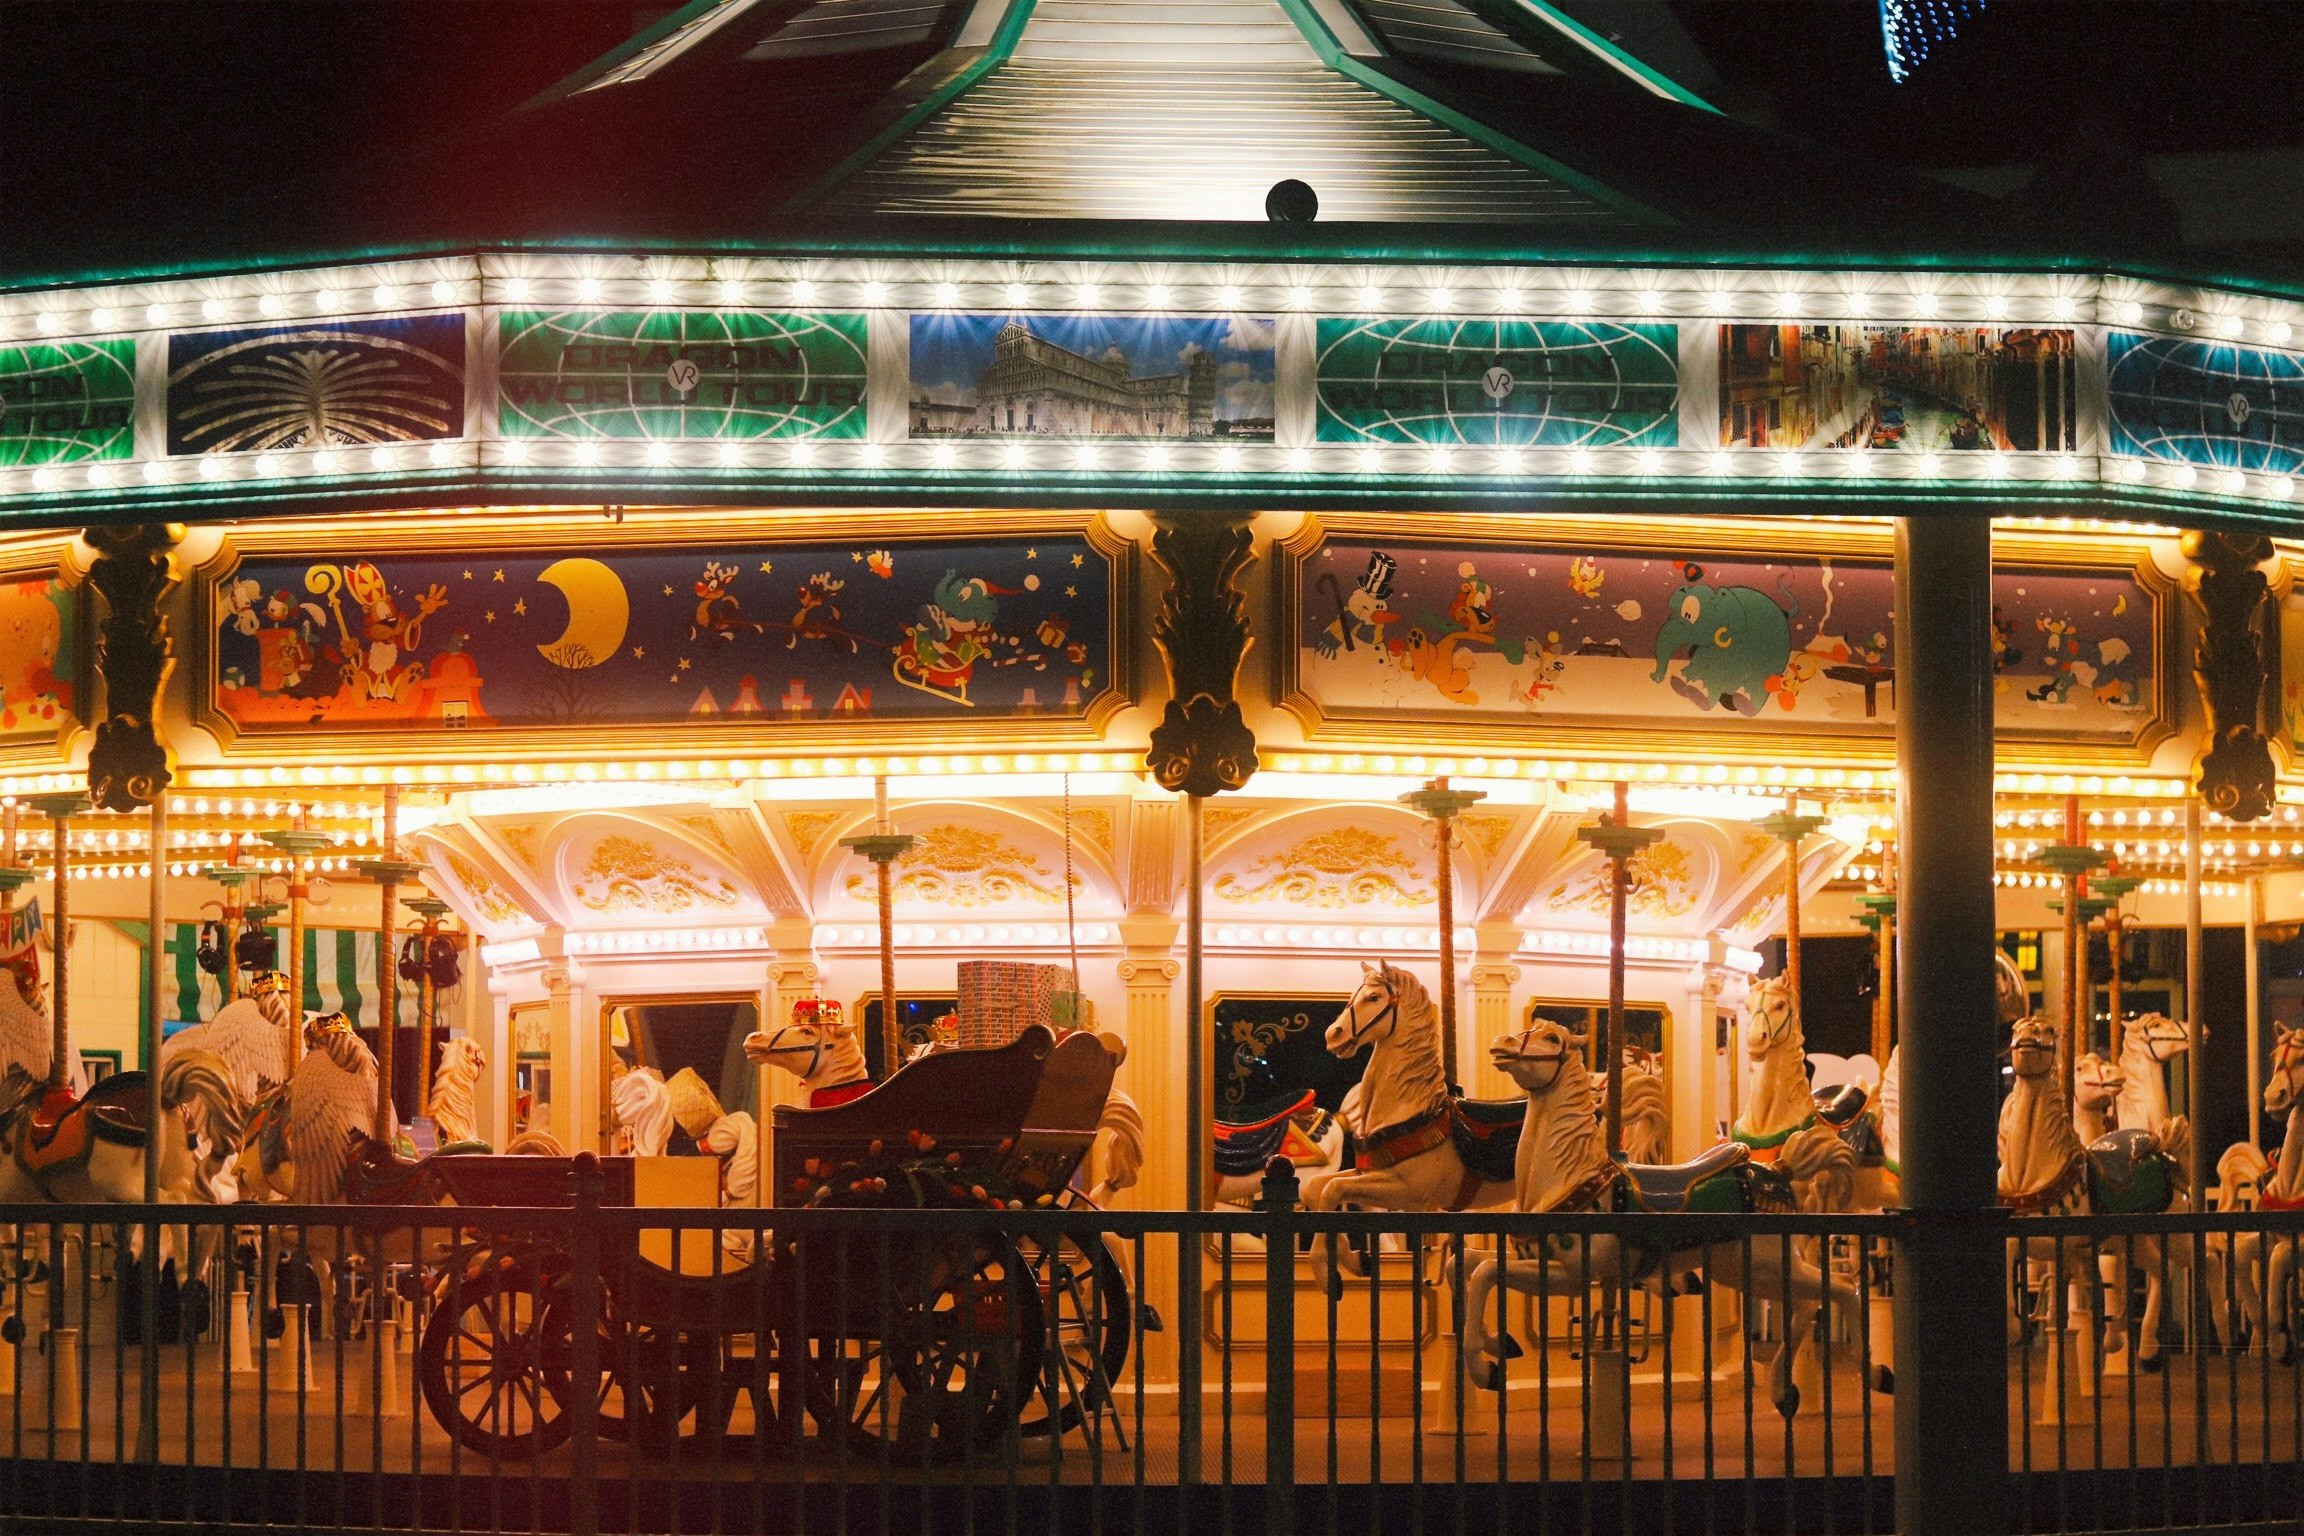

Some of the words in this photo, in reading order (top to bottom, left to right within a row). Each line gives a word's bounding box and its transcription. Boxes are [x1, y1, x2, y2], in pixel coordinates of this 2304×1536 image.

[562, 344, 801, 370] DRAGON
[1379, 351, 1614, 377] DRAGON
[504, 381, 698, 405] WORLD
[716, 382, 860, 406] TOUR
[1533, 389, 1672, 415] TOUR
